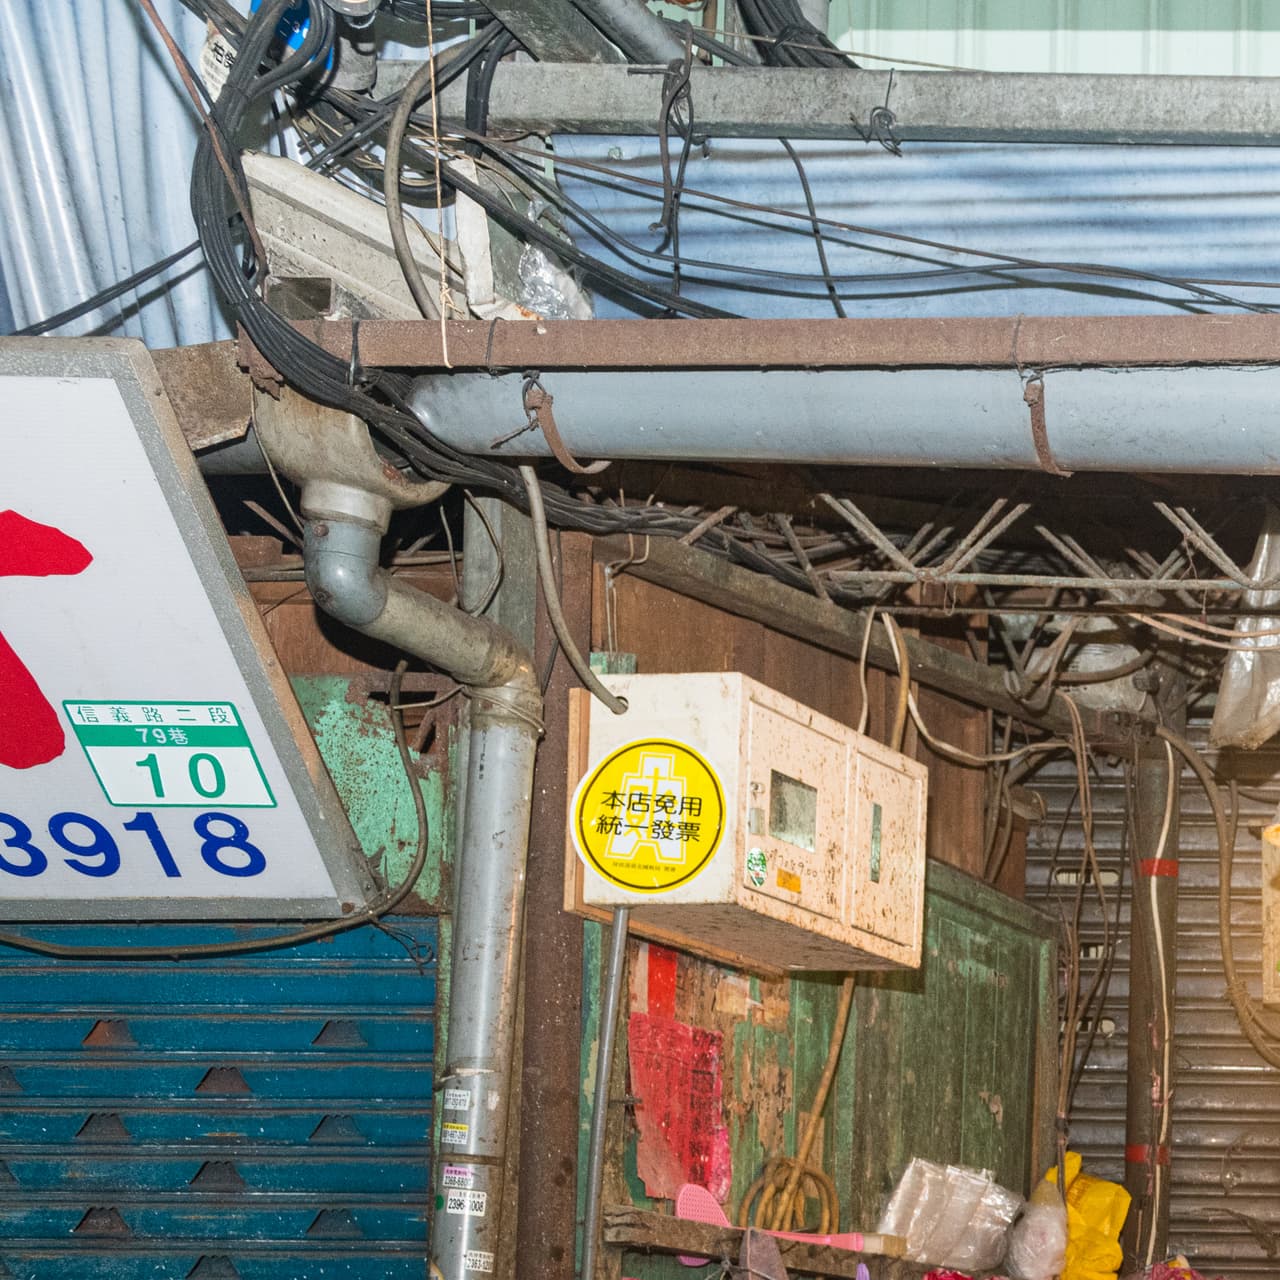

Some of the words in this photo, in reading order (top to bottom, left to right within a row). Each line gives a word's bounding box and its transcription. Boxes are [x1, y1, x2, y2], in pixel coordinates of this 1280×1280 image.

[77, 705, 231, 724] 信義路二段
[135, 727, 189, 745] 79巷
[136, 753, 226, 798] 10
[601, 790, 703, 817] 本店免用
[596, 815, 701, 842] 統一發票
